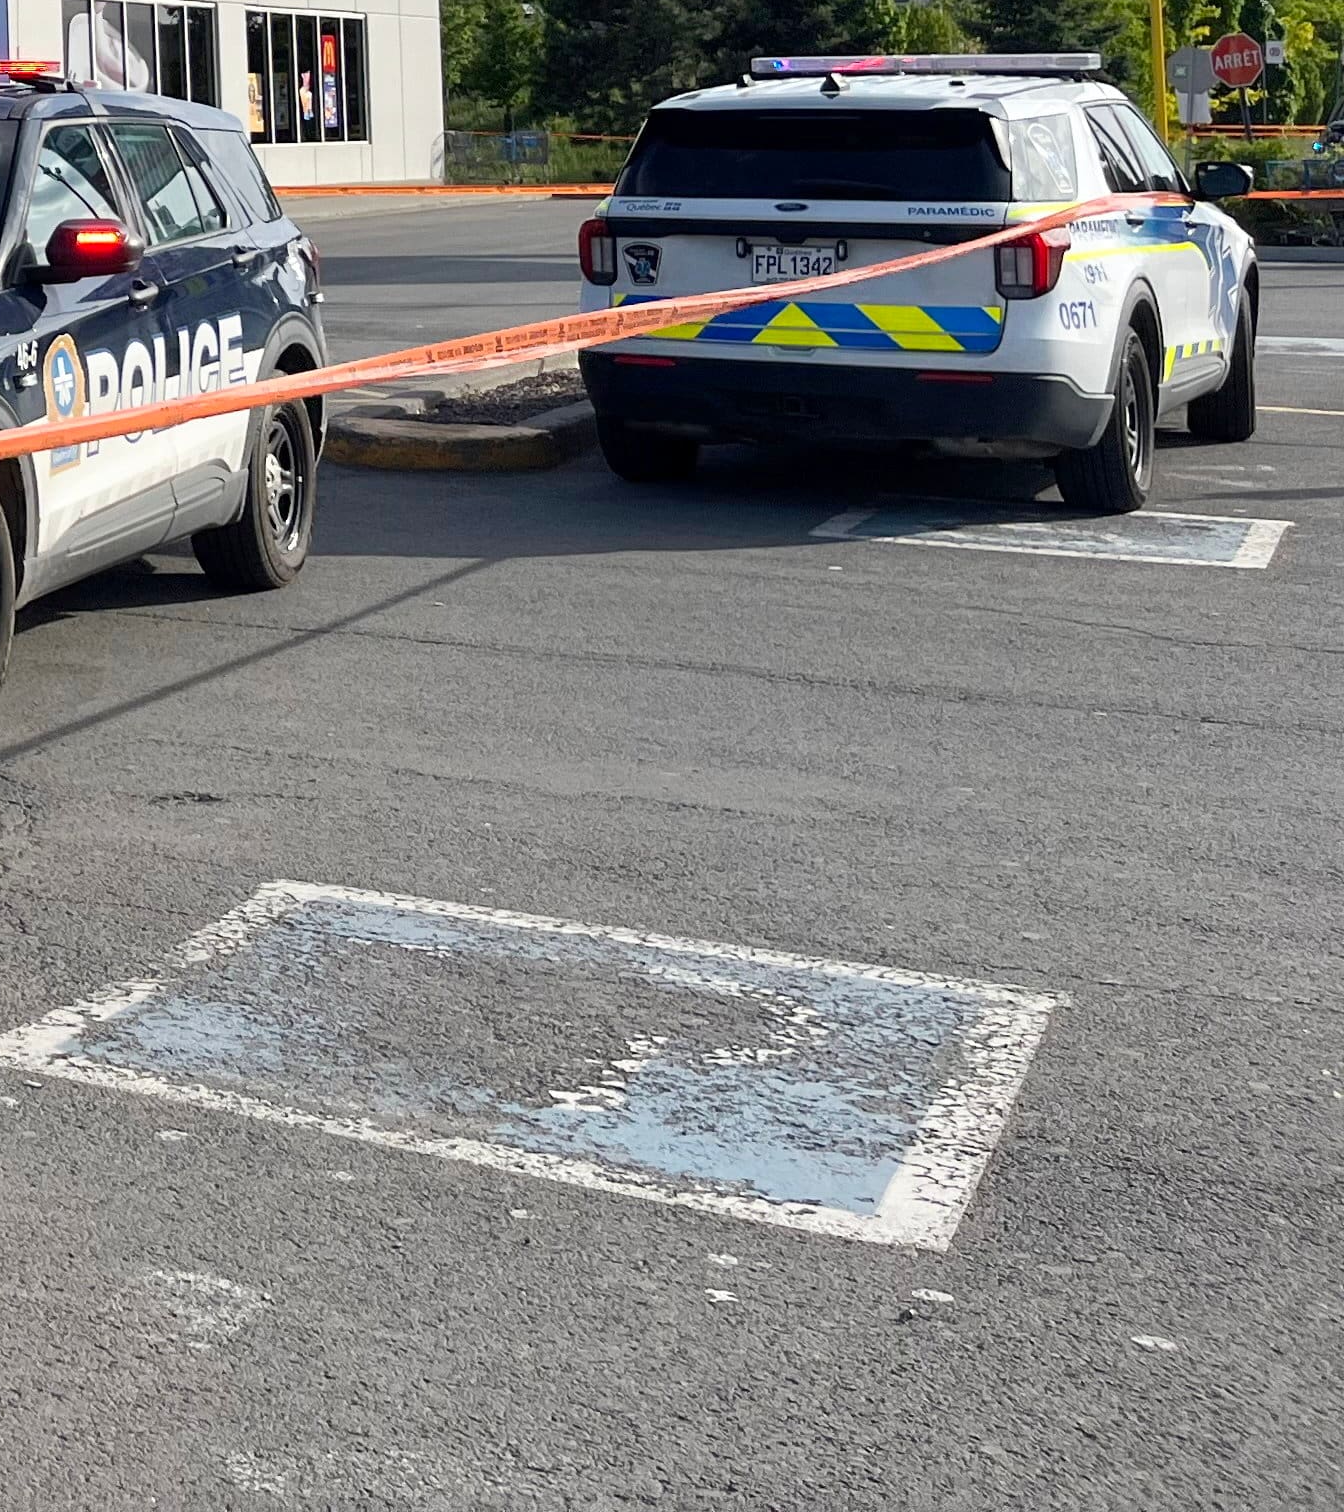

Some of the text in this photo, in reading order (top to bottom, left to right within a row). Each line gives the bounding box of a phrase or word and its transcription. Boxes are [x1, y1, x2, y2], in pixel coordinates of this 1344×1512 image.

[1214, 49, 1261, 72] ARRÊT
[907, 205, 995, 217] PARAMÉDIC
[755, 254, 833, 276] FPL 1342
[1058, 300, 1097, 330] 0671
[16, 339, 39, 370] 46-6
[84, 312, 247, 457] POLICE
